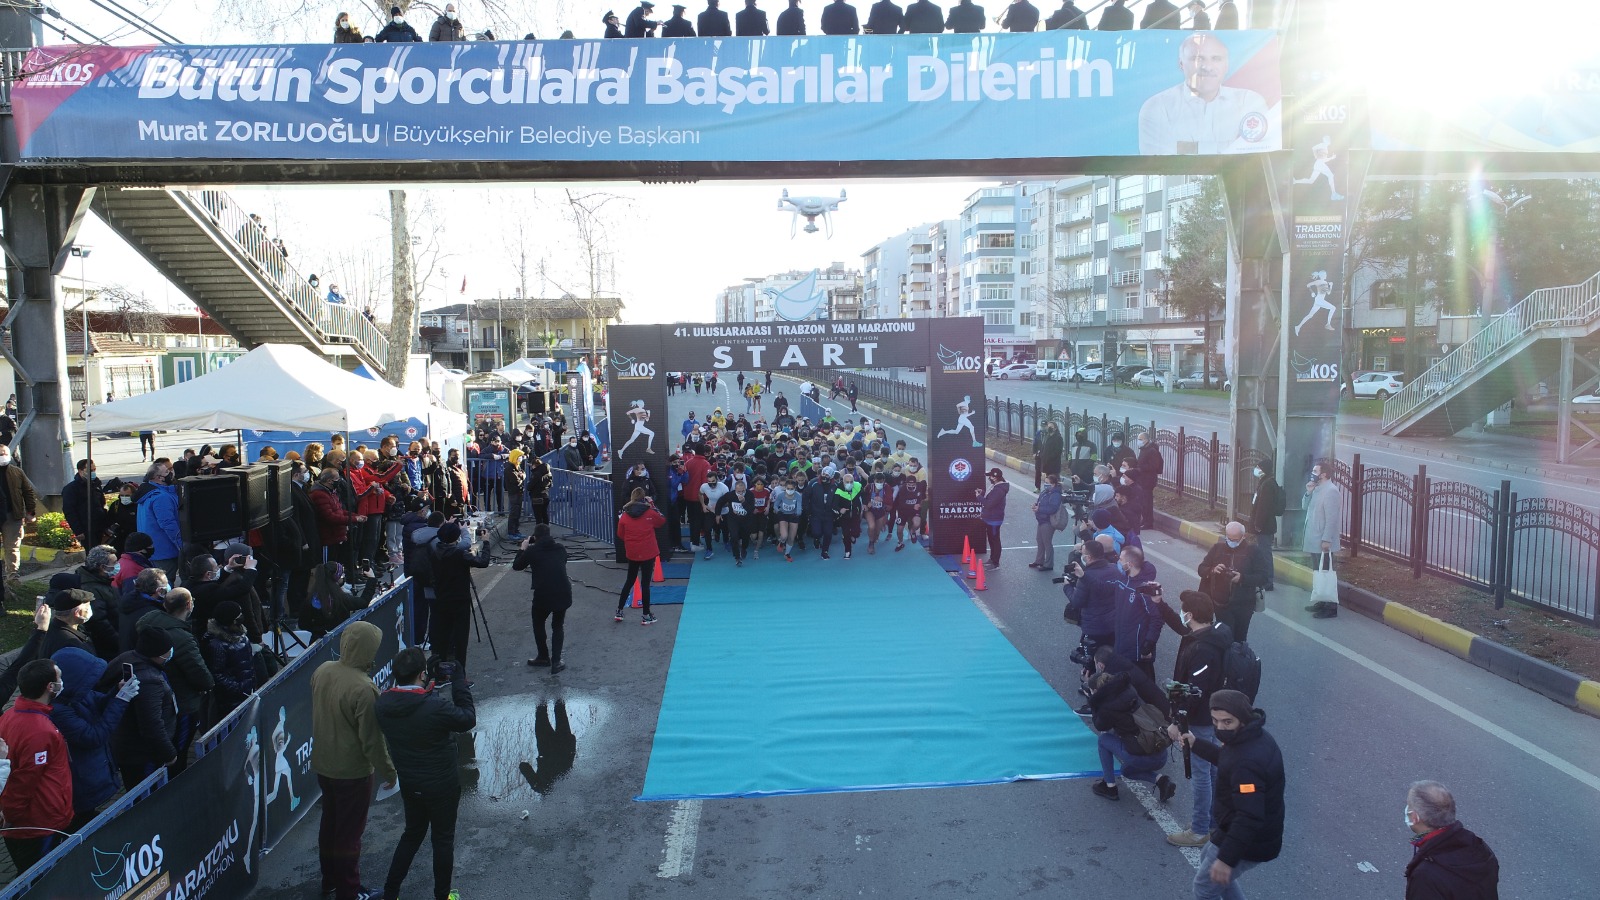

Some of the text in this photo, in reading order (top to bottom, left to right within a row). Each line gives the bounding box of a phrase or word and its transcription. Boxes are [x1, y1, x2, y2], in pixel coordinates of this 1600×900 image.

[138, 47, 1114, 115] Bütün Sporculara Başarılar Dilerim
[138, 117, 701, 148] Murat ZORLUOĞLU Büyükşehir Belediye Başkanı
[1295, 224, 1342, 232] TRABZON
[673, 322, 916, 338] 41. ULUSLARARASI TRABZON YARI MARATONU
[712, 342, 878, 369] START
[940, 506, 983, 514] TRABZON
[125, 834, 164, 890] KOŞ
